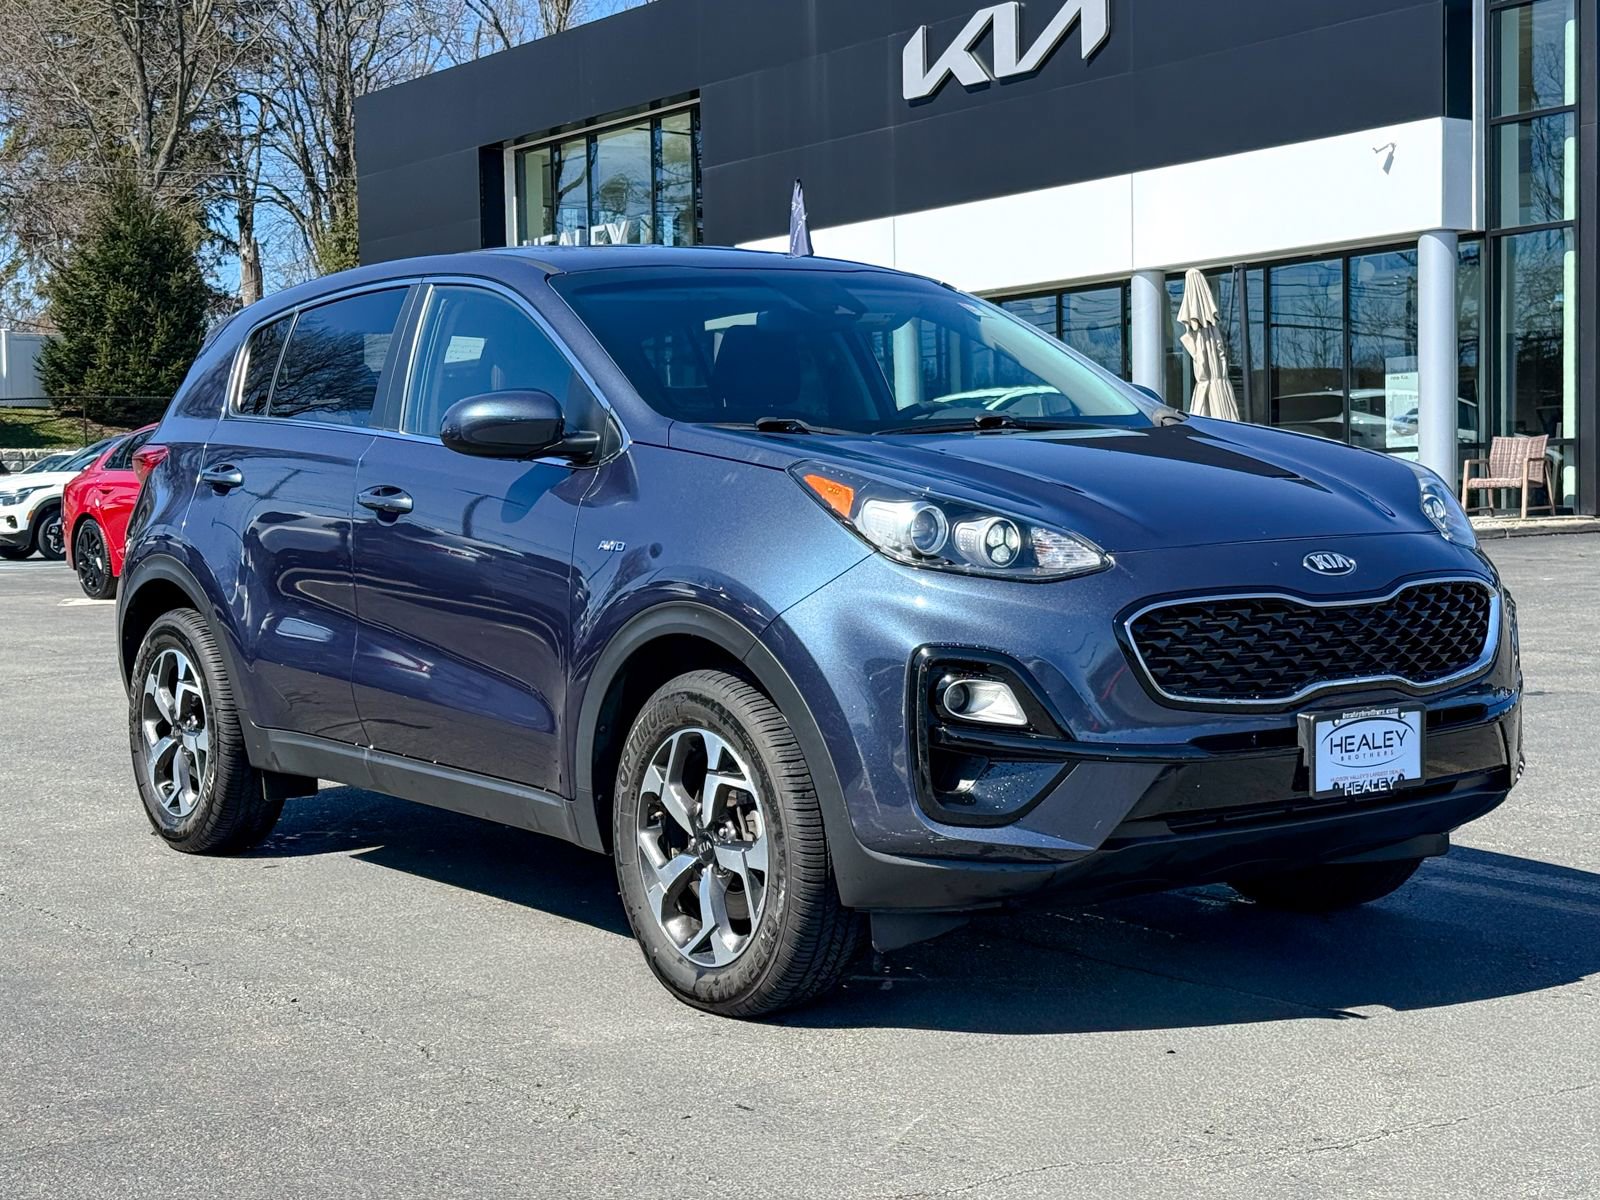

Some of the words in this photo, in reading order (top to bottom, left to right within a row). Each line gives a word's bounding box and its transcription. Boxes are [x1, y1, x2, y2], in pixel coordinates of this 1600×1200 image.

[522, 220, 629, 246] ALEY
[597, 540, 627, 552] AWD
[1308, 553, 1351, 570] KIA
[1330, 729, 1407, 755] HEALEY
[1340, 750, 1395, 761] BROTHERS
[1344, 777, 1395, 796] HEALEY
